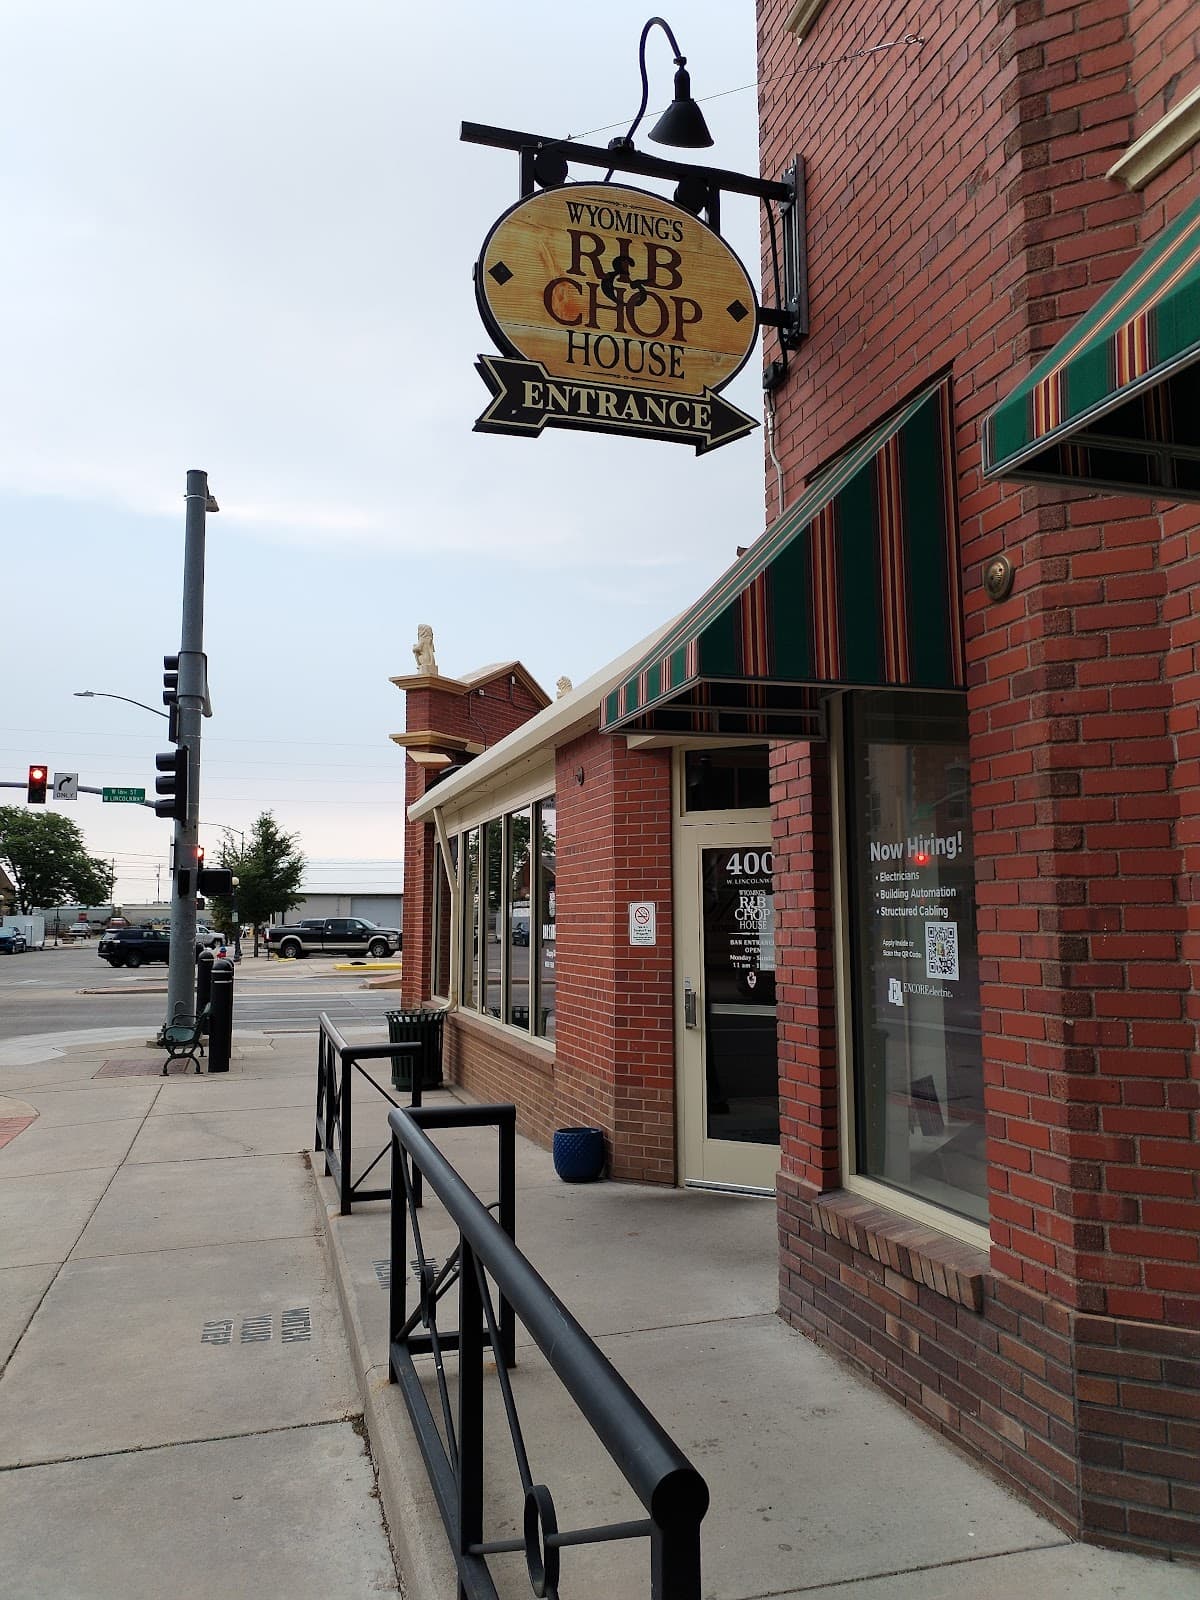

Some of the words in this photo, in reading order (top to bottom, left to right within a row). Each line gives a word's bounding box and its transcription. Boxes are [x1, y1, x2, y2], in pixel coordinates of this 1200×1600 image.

[565, 201, 684, 242] WYOMING'S
[566, 229, 683, 290] RIB
[543, 277, 703, 342] CHOP
[565, 330, 685, 380] HOUSE
[521, 380, 712, 431] ENTRANCE
[870, 841, 904, 862] Now
[907, 831, 963, 860] Hiring!
[879, 870, 920, 882] Electricians
[739, 896, 766, 909] RIB
[880, 888, 909, 901] Building
[910, 886, 957, 898] Automation
[734, 908, 771, 921] CHOP
[739, 920, 768, 930] HOUSE
[880, 905, 918, 917] Structured
[919, 904, 949, 918] Cabling
[200, 1319, 234, 1346] STEP
[240, 1313, 272, 1344] YOUR
[281, 1306, 311, 1344] WATCH
